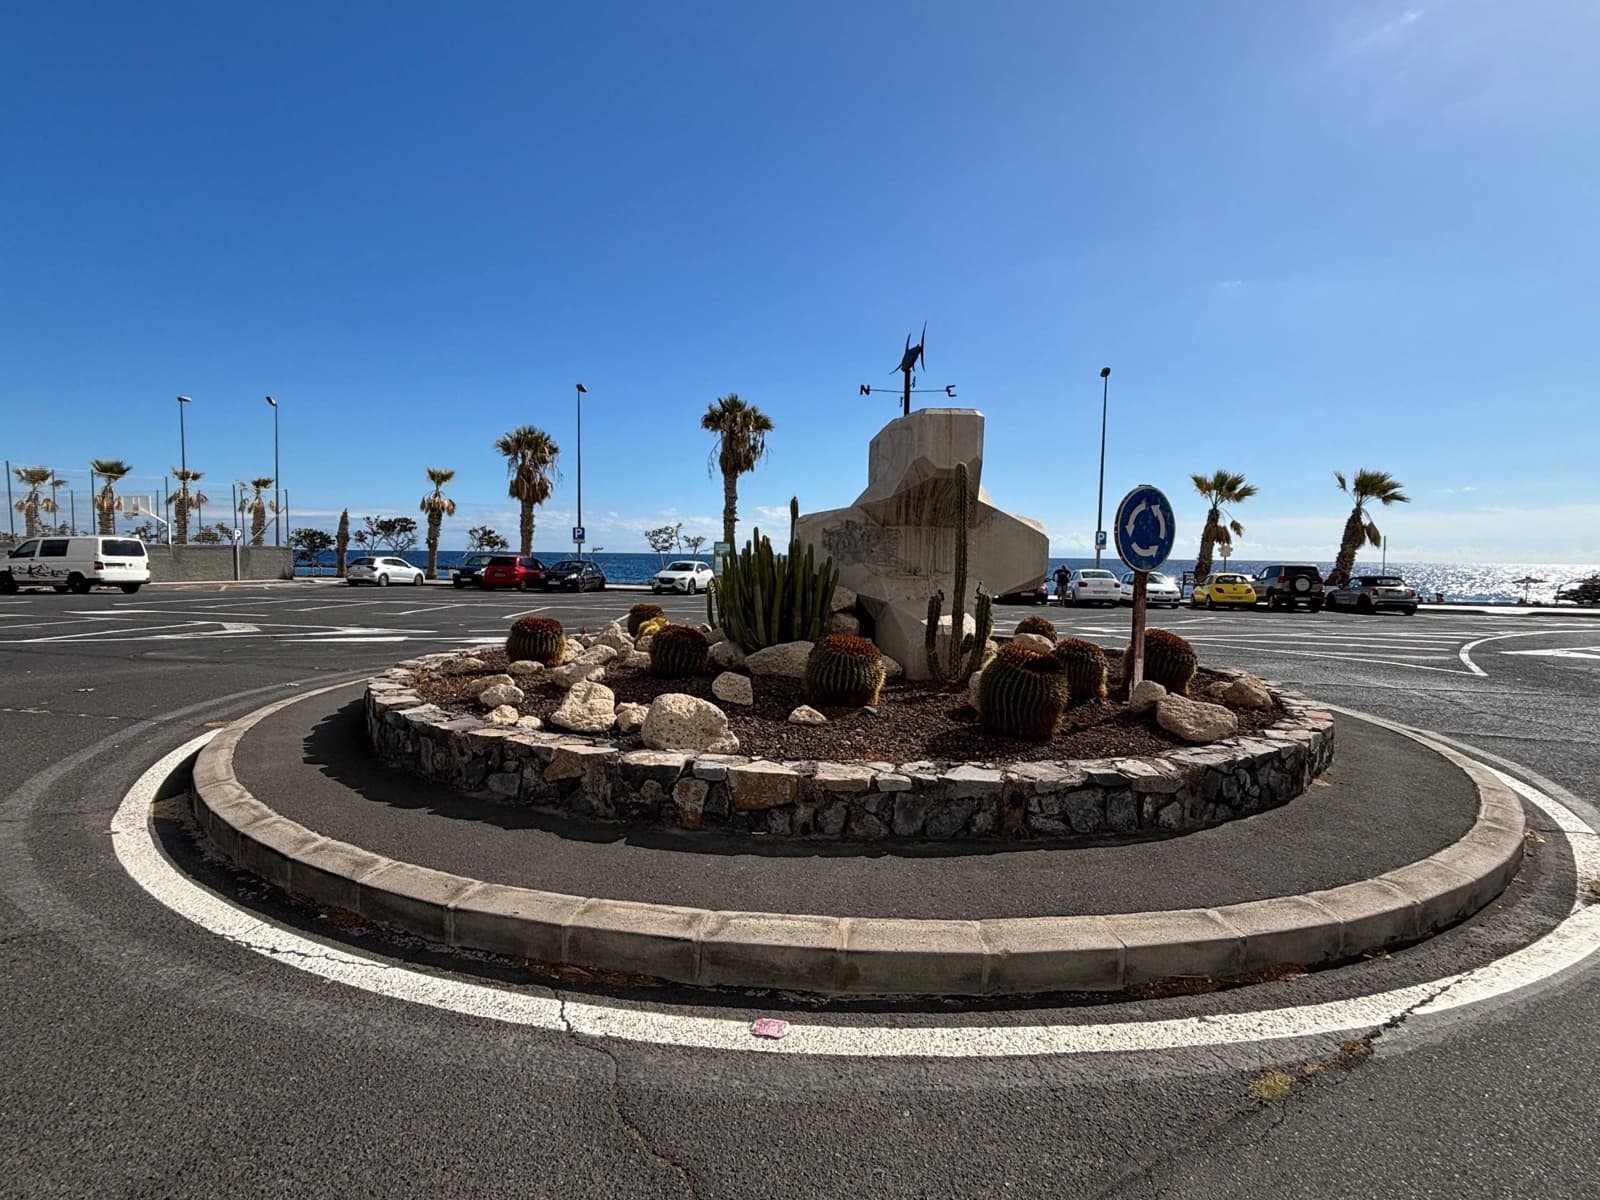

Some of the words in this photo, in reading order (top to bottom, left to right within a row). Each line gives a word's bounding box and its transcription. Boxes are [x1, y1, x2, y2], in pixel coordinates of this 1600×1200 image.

[235, 530, 241, 540] P
[575, 529, 582, 538] P
[1098, 533, 1104, 543] P
